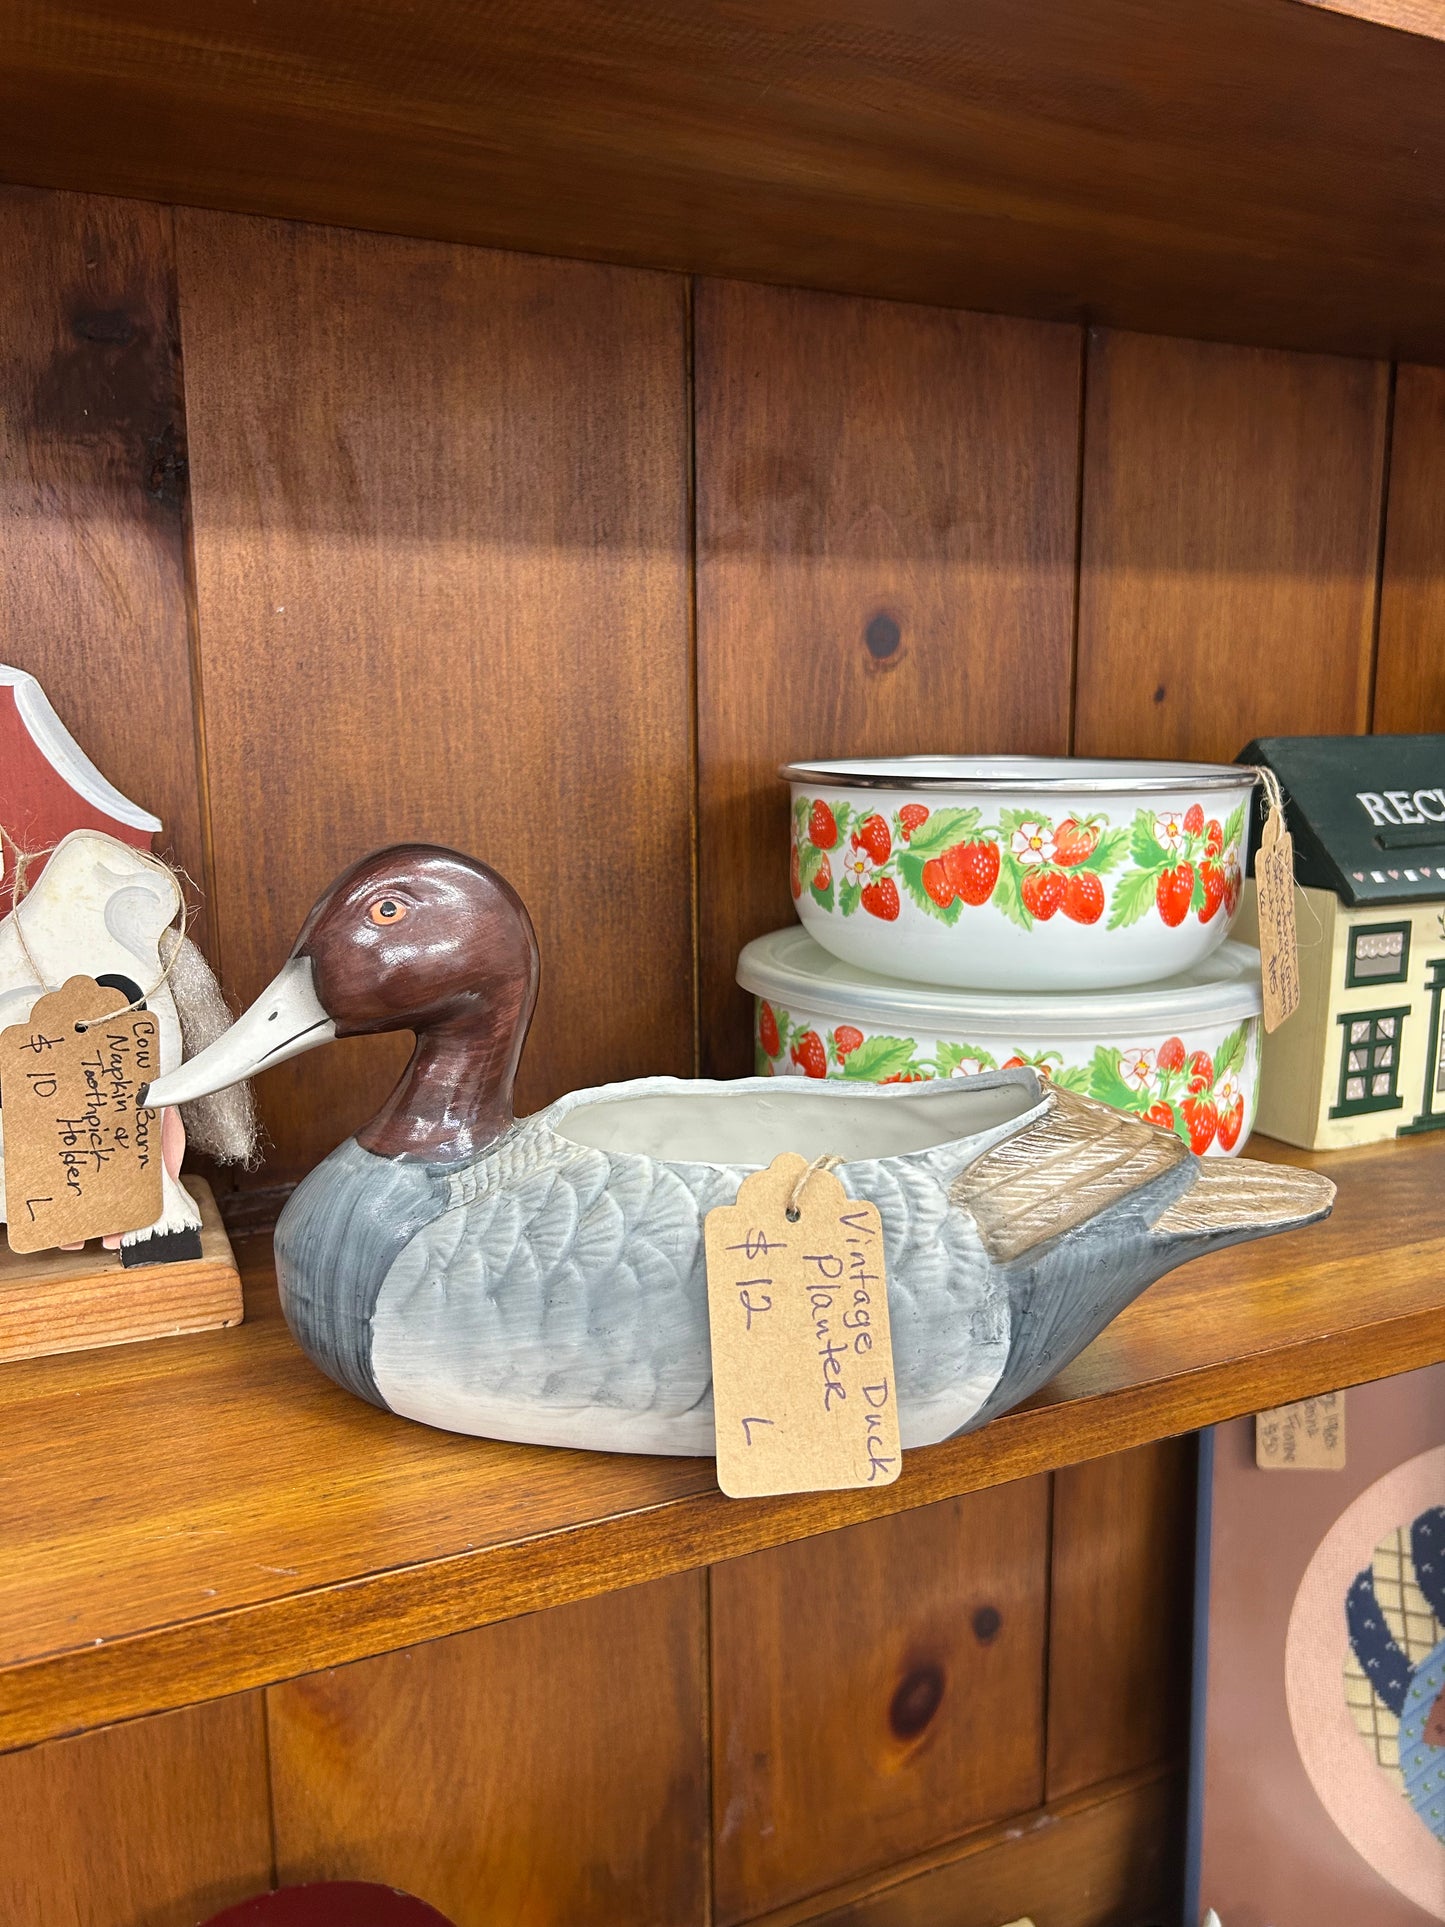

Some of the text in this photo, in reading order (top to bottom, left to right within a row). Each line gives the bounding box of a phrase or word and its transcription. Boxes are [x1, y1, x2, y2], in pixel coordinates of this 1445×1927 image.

[106, 1034, 135, 1113] Napkin
[132, 1020, 155, 1069] Cow
[80, 1049, 116, 1174] Toothpick
[134, 1107, 156, 1170] Barn
[55, 1117, 89, 1197] Holder
[26, 1197, 53, 1222] L
[838, 1210, 897, 1483] Vintage Duck
